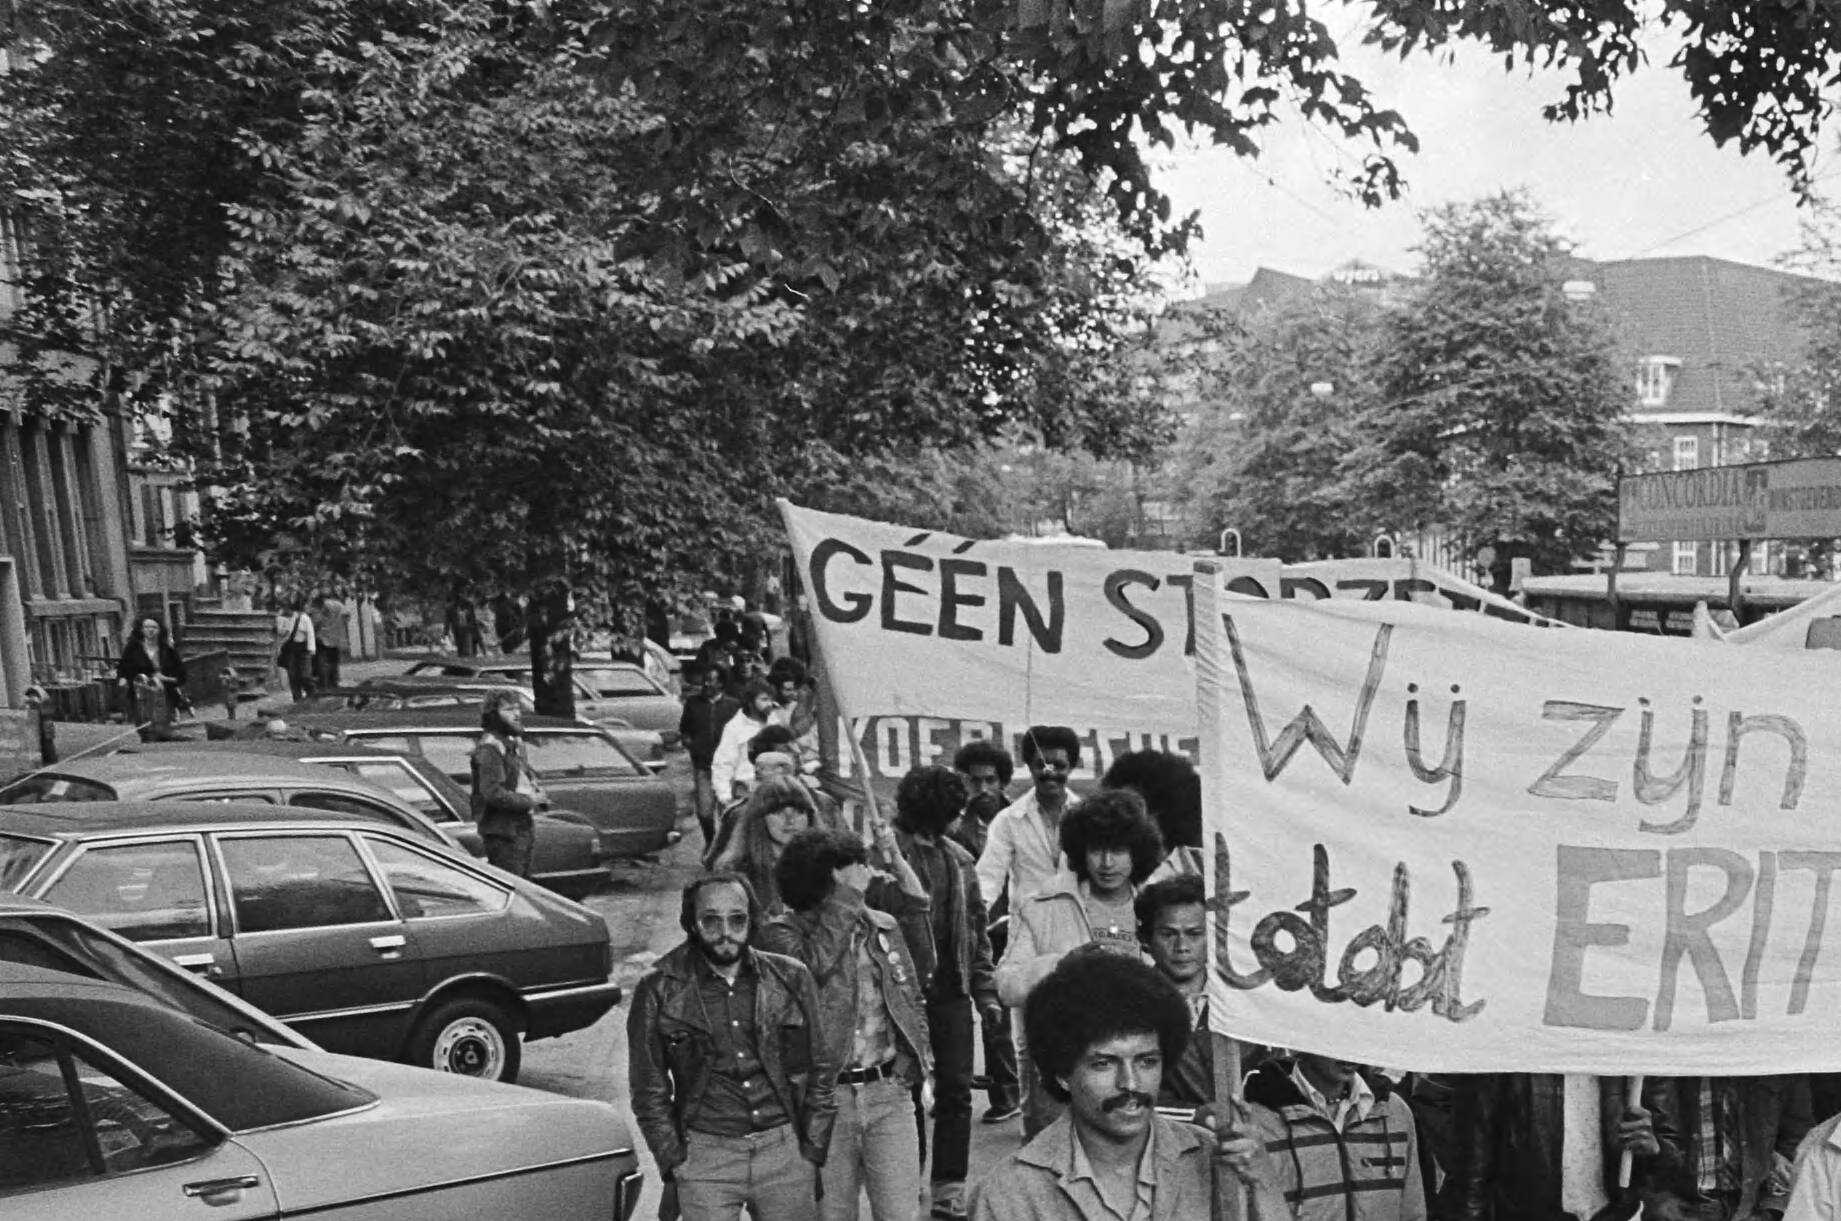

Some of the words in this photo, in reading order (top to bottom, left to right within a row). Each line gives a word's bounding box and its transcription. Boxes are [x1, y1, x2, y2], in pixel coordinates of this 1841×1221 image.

[808, 532, 1065, 654] GÉÉN
[1221, 612, 1466, 818] Wij
[1526, 694, 1809, 835] zijn
